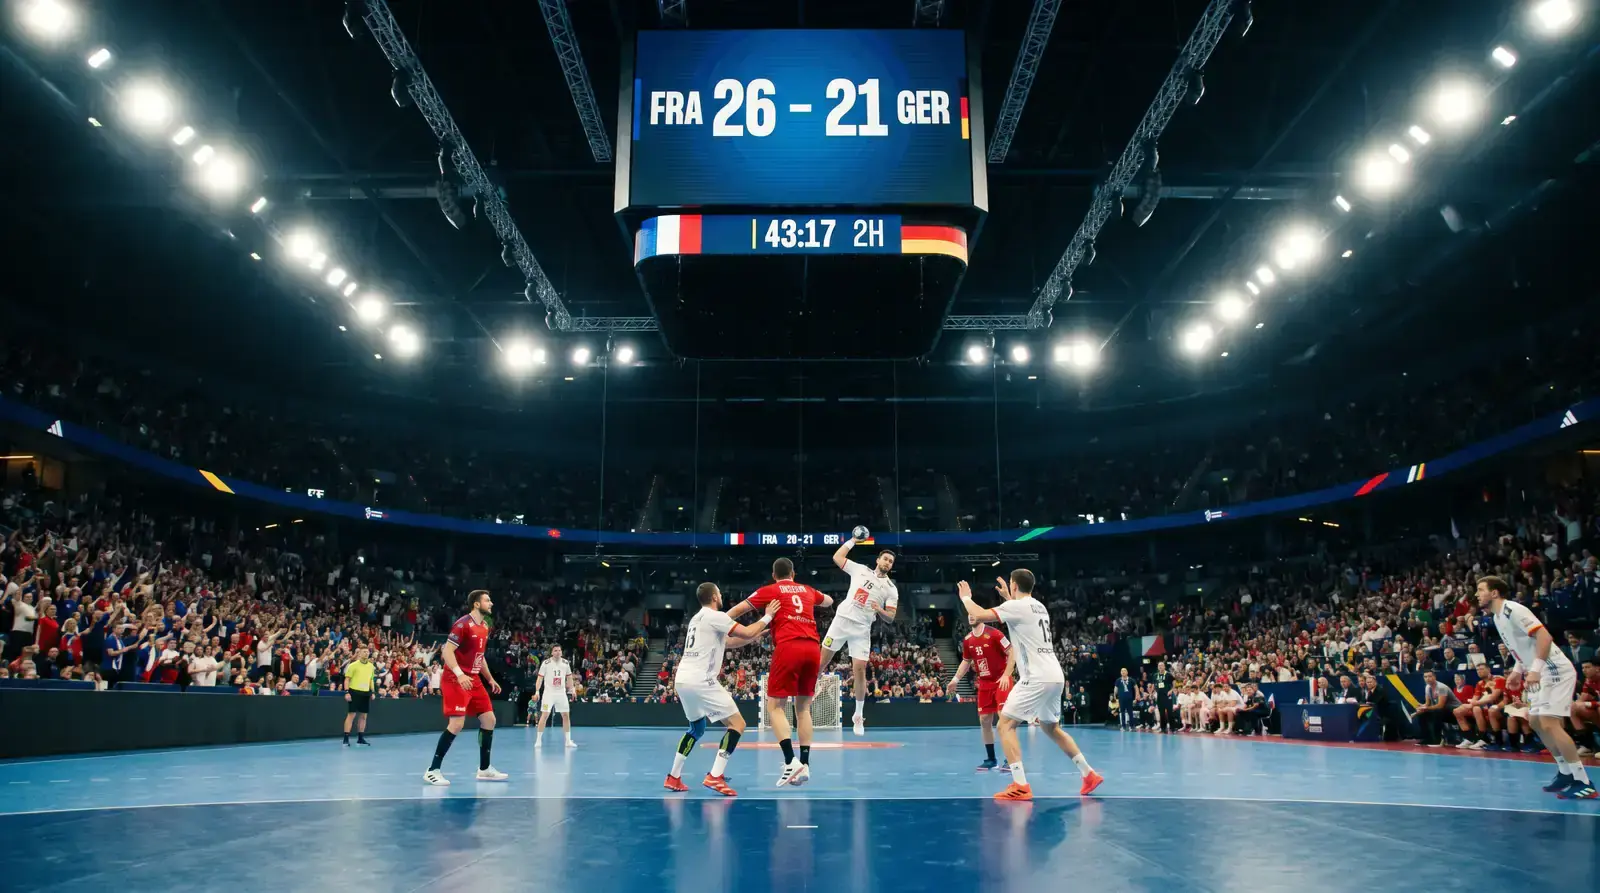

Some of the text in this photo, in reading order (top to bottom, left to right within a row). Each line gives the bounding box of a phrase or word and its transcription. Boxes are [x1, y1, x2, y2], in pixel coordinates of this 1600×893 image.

[650, 91, 703, 125] FRA
[713, 78, 776, 137] 26
[825, 78, 888, 137] 21
[897, 90, 951, 125] GER
[764, 218, 884, 248] 43:17 2H
[762, 534, 778, 545] FRA
[823, 534, 840, 545] GER
[791, 594, 803, 614] 9
